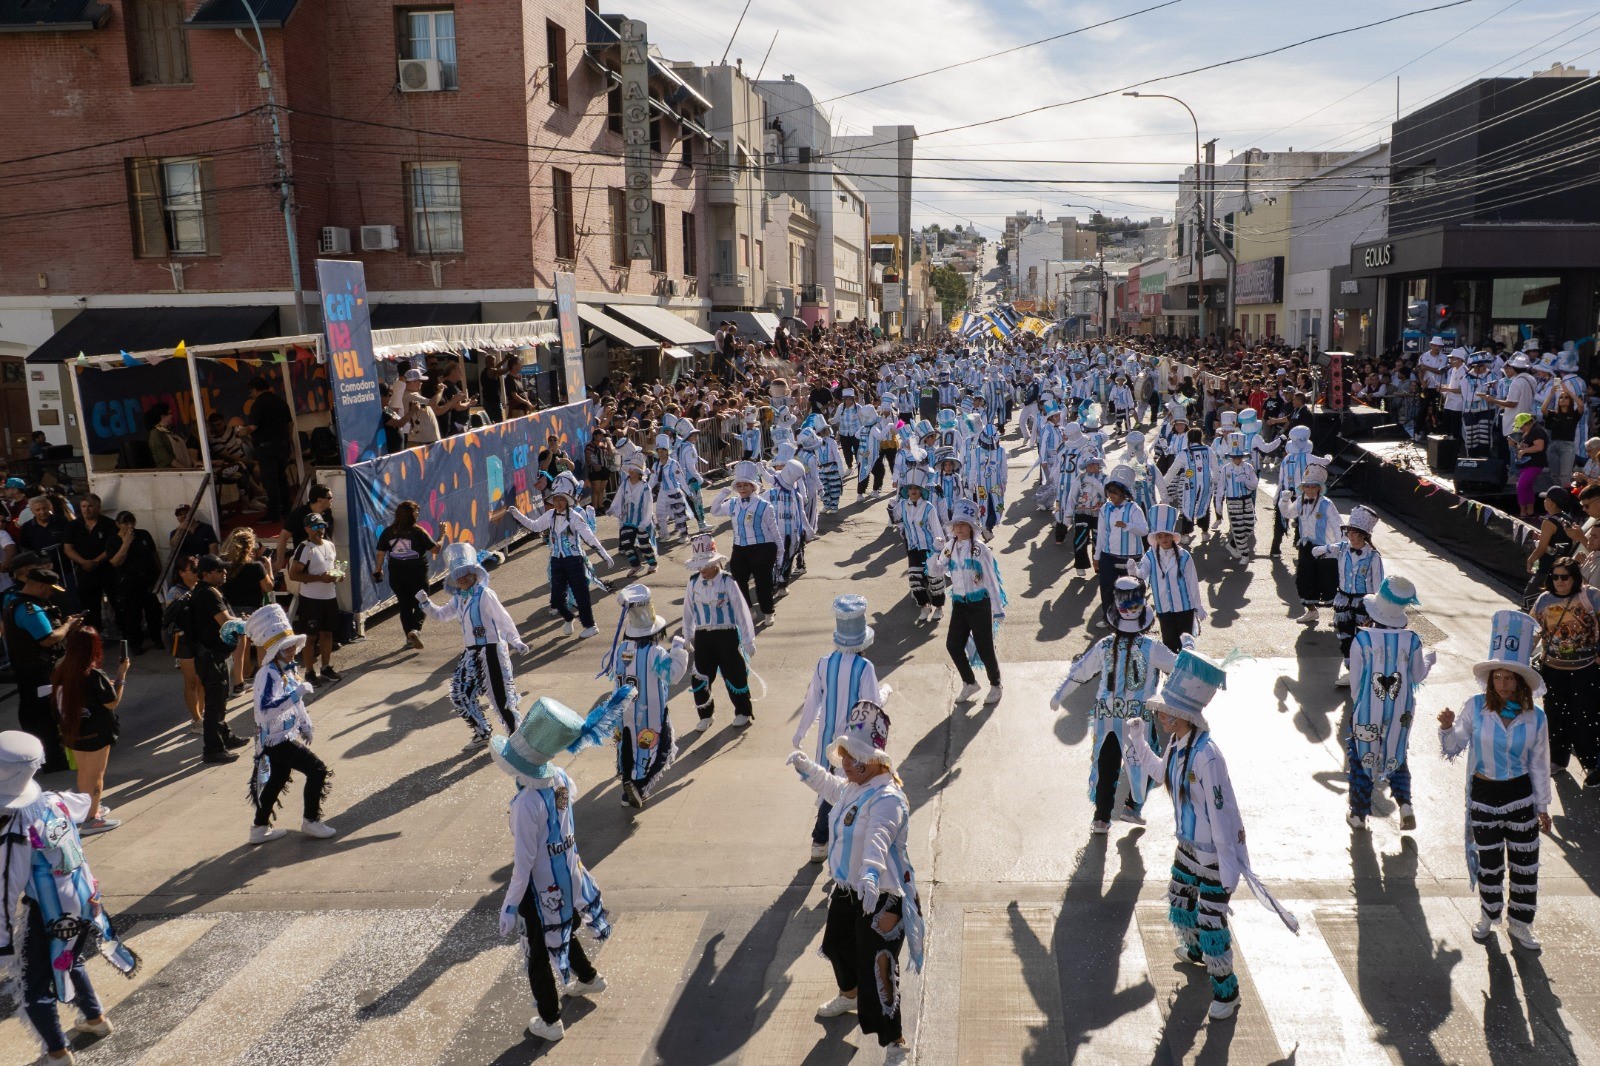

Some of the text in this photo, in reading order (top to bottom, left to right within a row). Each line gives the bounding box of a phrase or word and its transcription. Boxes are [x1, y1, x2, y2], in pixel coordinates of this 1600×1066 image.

[623, 23, 650, 259] LA AGRICOLA
[326, 293, 355, 322] car
[328, 322, 351, 350] na
[340, 380, 376, 393] Comodoro
[341, 390, 375, 406] Rivadavia
[1060, 453, 1077, 474] 23
[963, 506, 975, 517] 22
[1493, 635, 1520, 652] 10
